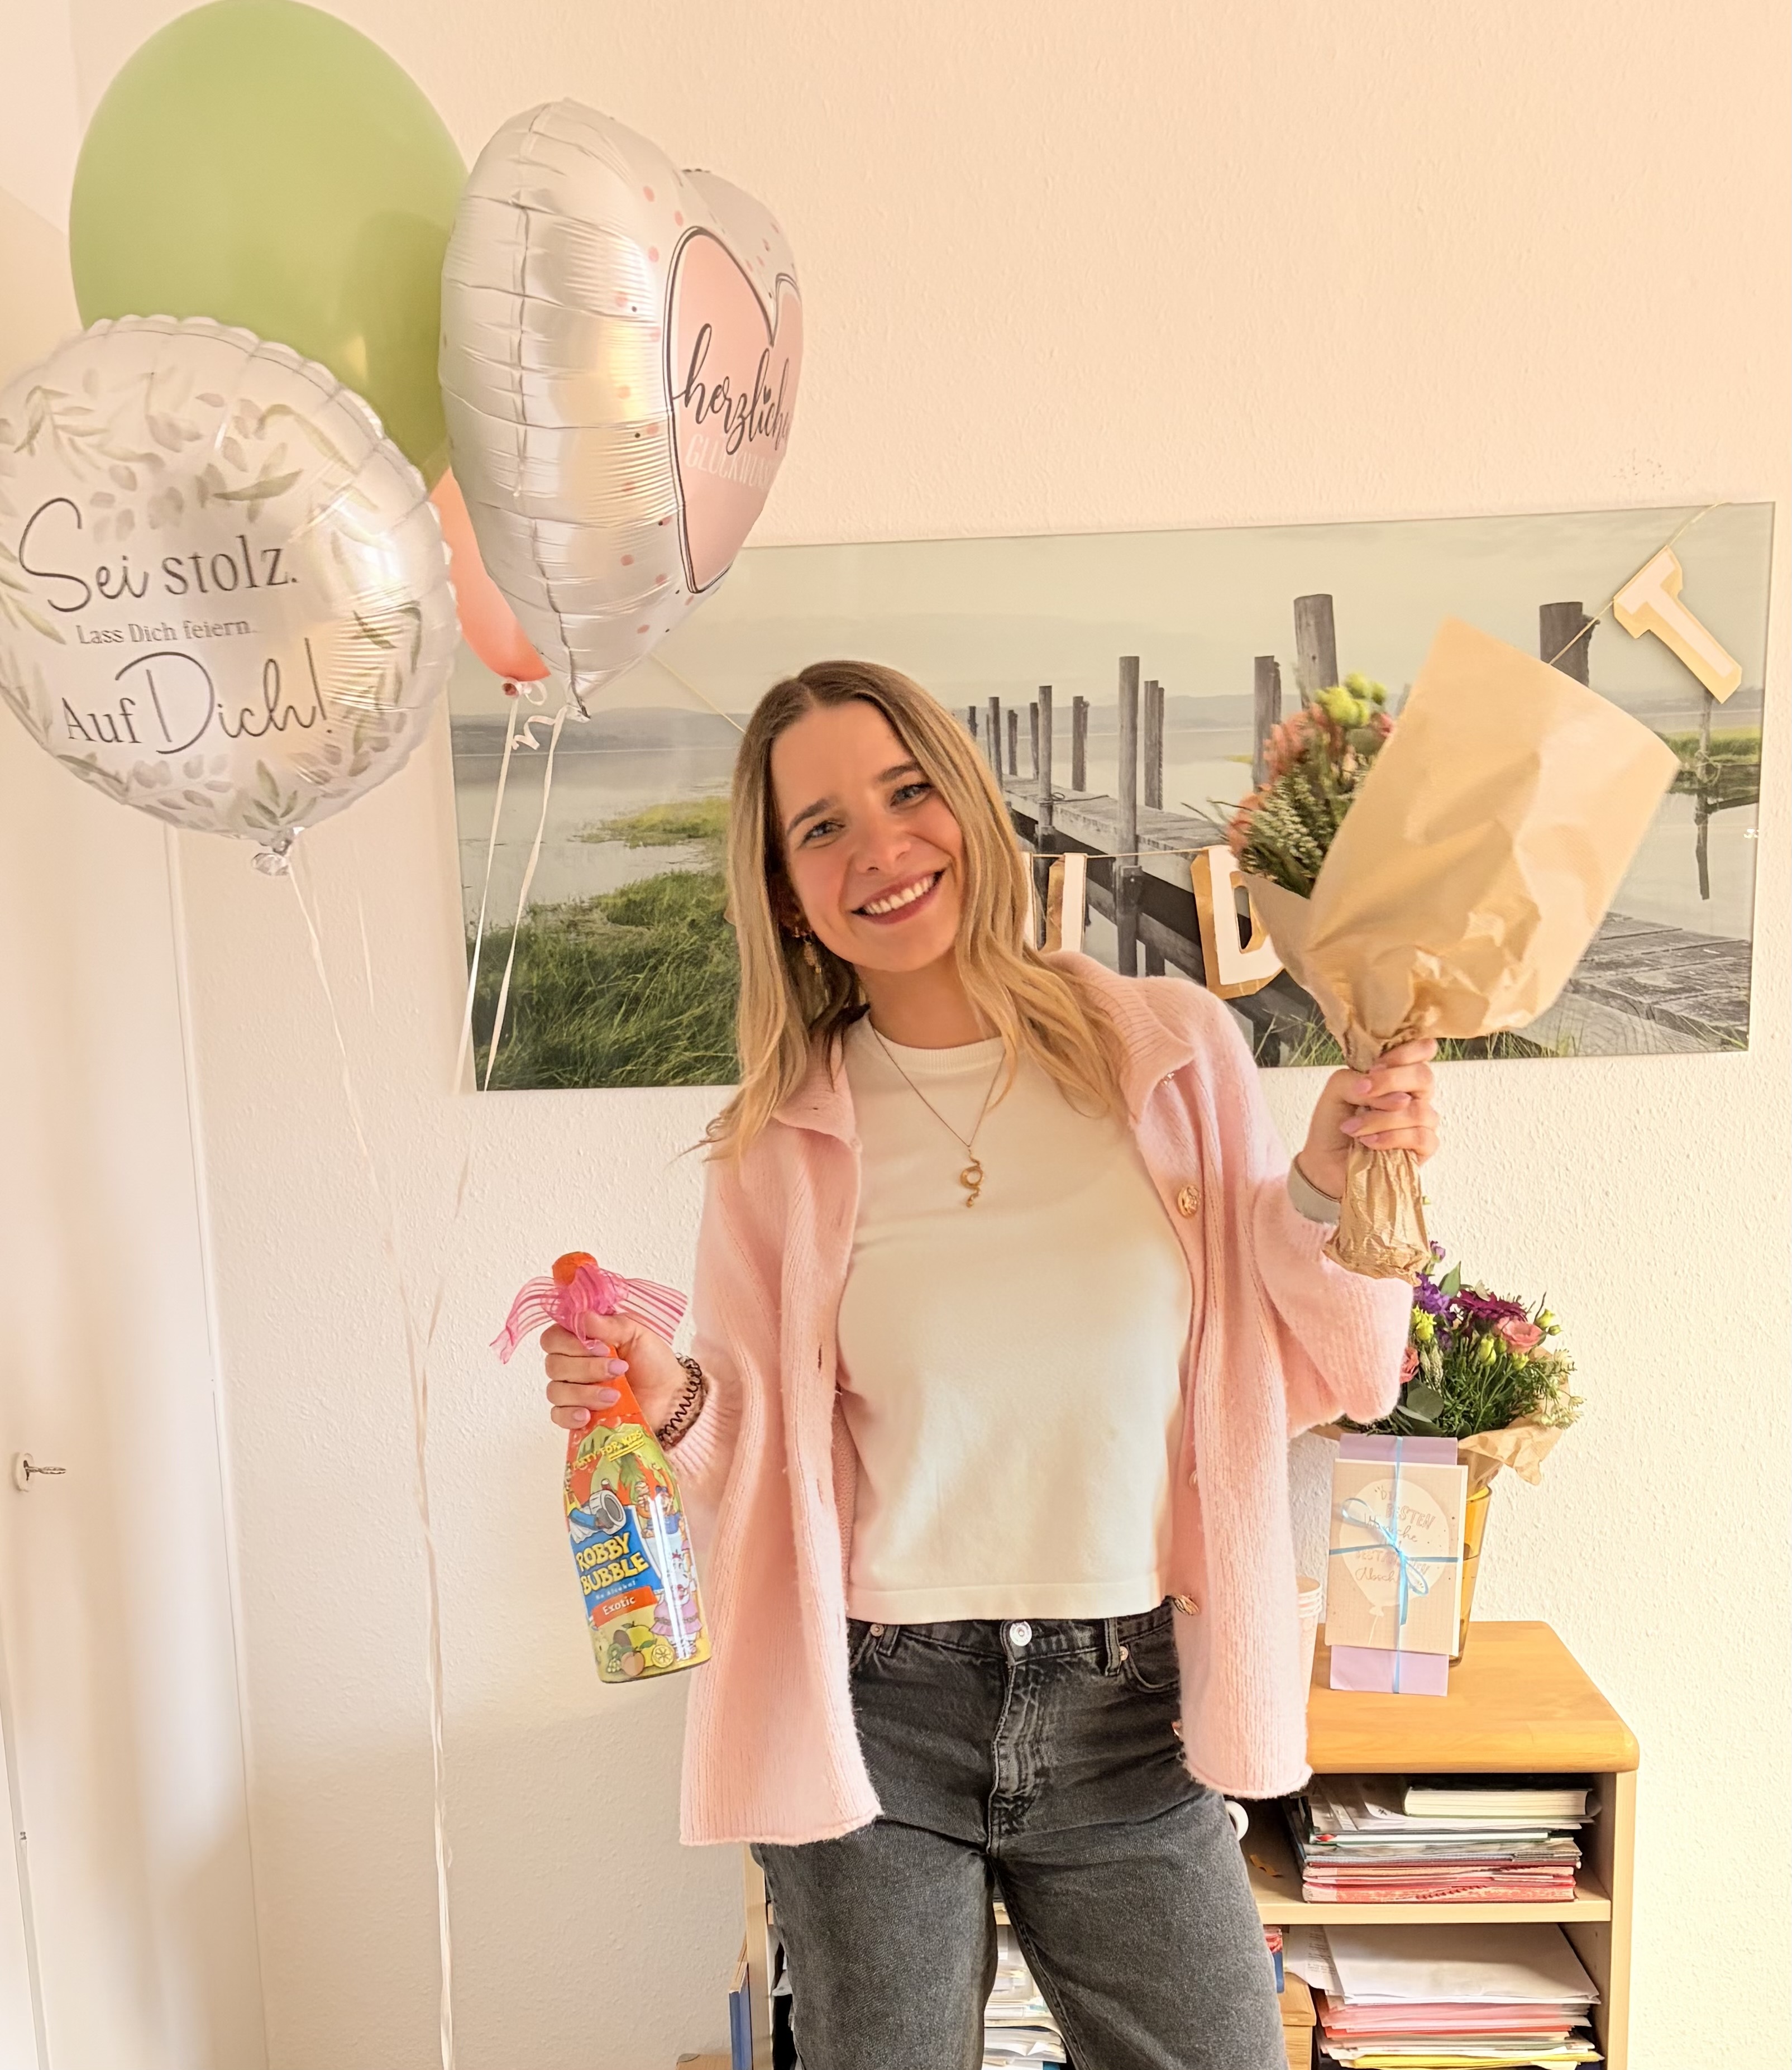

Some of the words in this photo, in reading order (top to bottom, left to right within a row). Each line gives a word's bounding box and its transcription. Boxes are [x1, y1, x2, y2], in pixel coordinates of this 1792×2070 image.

[19, 497, 149, 613] Sei
[161, 534, 298, 595] stolz.
[75, 625, 124, 644] Lass
[128, 623, 178, 642] Dich
[61, 697, 142, 745] Auf
[115, 637, 333, 755] Dich!
[600, 1441, 621, 1456] FOR
[575, 1532, 630, 1573] ROBBY
[580, 1551, 650, 1596] BUBBLE
[602, 1596, 636, 1615] Exotic
